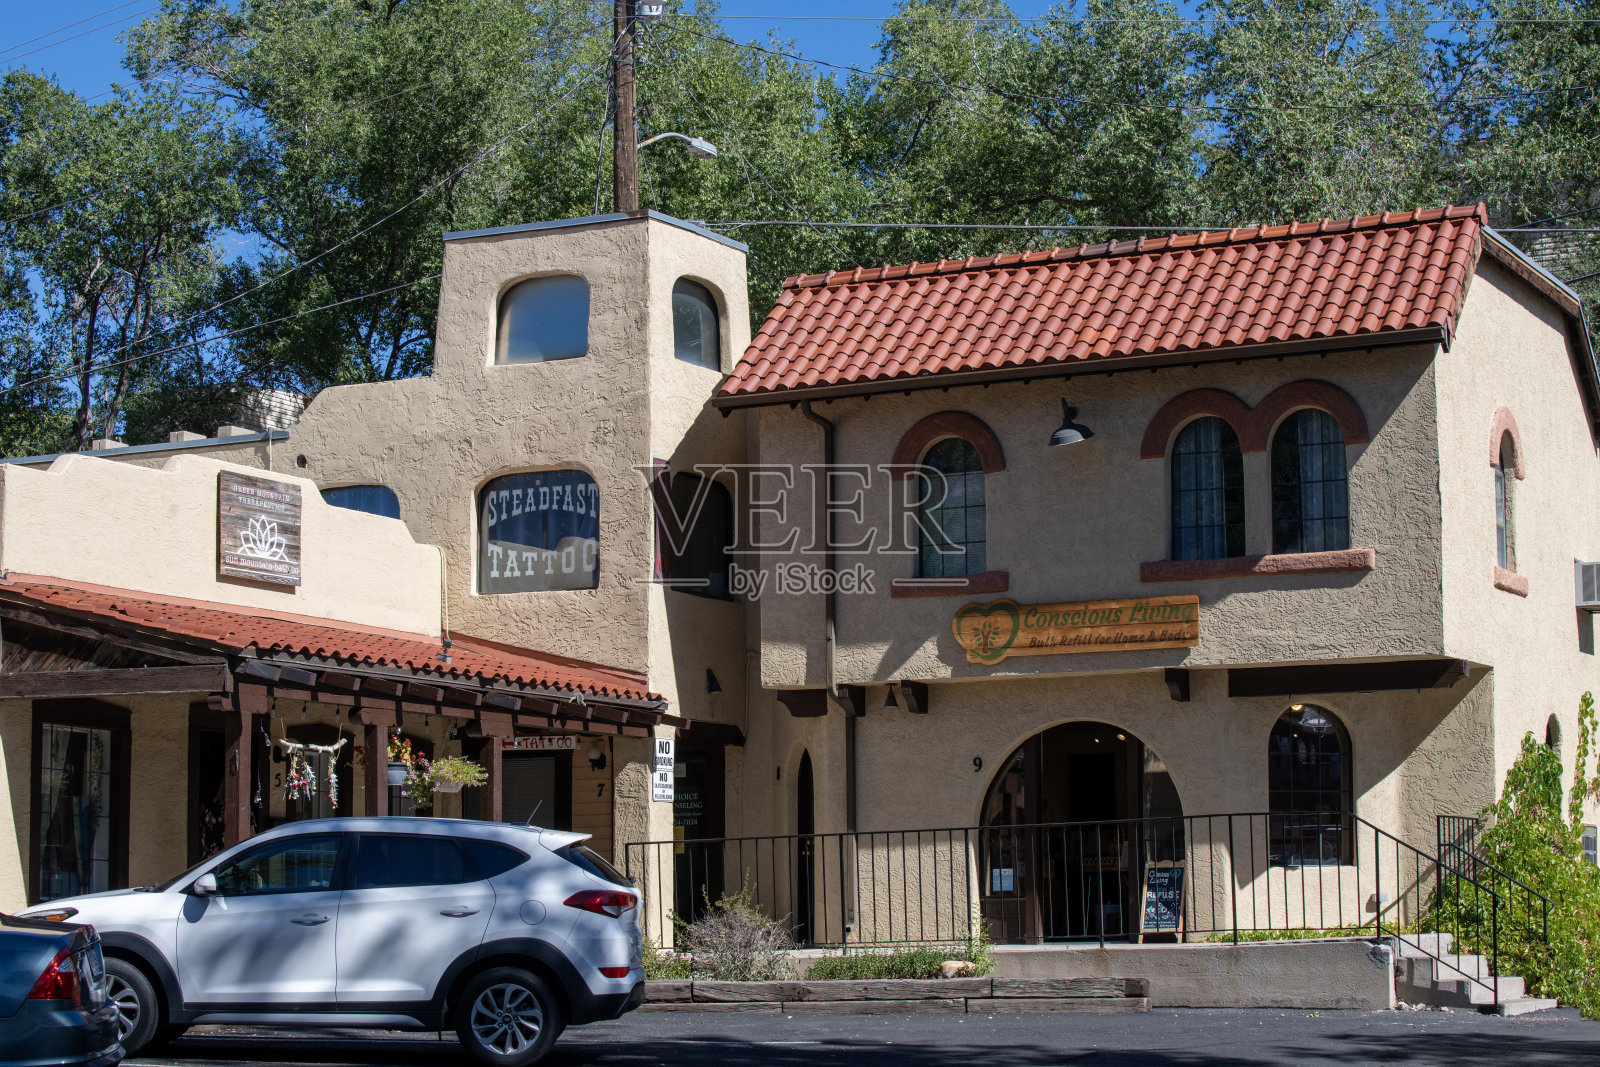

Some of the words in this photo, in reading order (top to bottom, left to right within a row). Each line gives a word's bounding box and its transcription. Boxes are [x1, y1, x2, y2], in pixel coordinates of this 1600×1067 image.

[233, 485, 255, 495] GREEN
[256, 489, 290, 501] MOUNTAIN
[239, 496, 285, 510] THERAPEUTICS
[488, 482, 598, 527] STEADFAST
[488, 537, 597, 578] TATTOO
[1024, 605, 1122, 629] Conscious
[1129, 601, 1194, 627] Living
[1029, 636, 1057, 648] Bulk
[1060, 633, 1093, 646] Refill
[1094, 633, 1112, 645] for
[1114, 631, 1145, 644] Home
[1148, 630, 1156, 642] &
[1160, 629, 1190, 643] Body
[658, 740, 670, 755] NO
[973, 756, 983, 772] 9
[275, 773, 281, 787] 5
[659, 772, 668, 782] NO
[597, 783, 605, 797] 7
